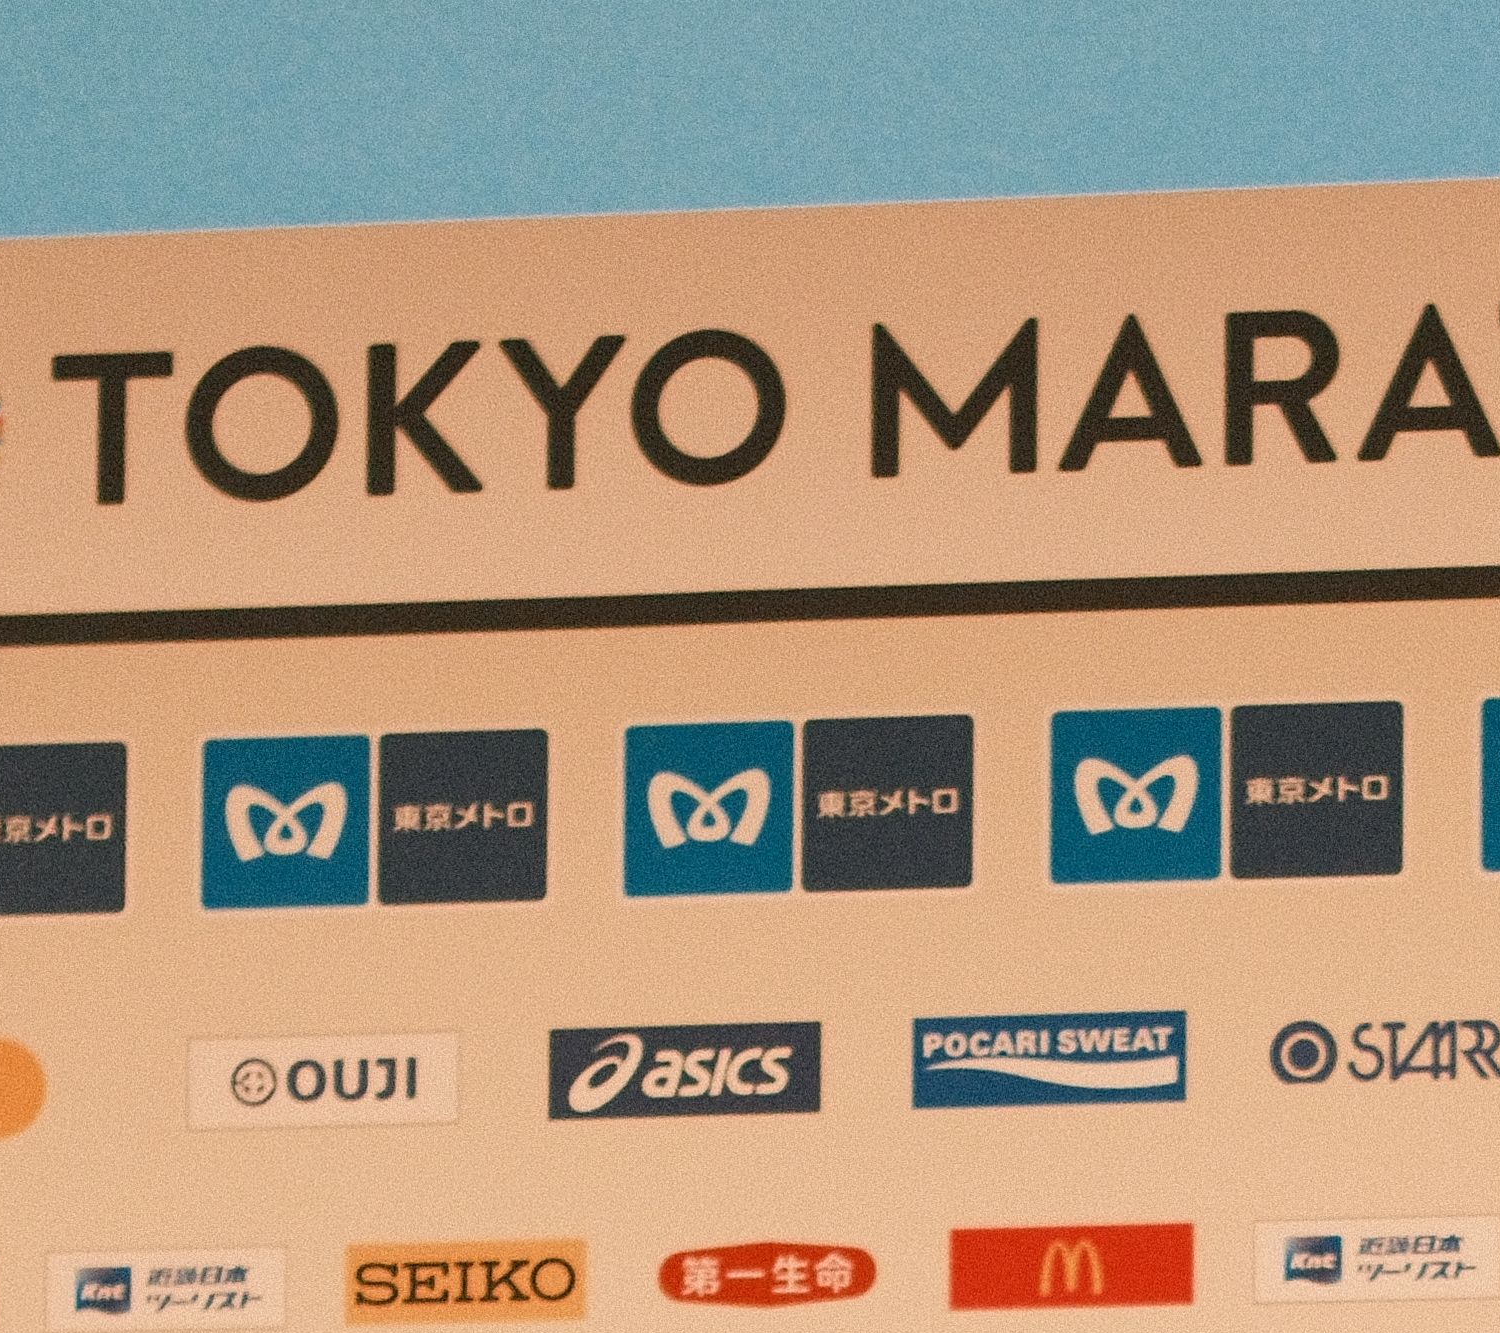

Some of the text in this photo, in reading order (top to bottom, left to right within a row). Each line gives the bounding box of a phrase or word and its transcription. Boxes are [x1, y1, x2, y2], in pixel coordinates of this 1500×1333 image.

[52, 329, 786, 505] TOKYO
[1248, 775, 1388, 803] 東京メトロ
[395, 802, 533, 830] 東京メトロ
[924, 1027, 1172, 1060] POCARI SWEAT
[287, 1057, 417, 1102] OUJI
[642, 1047, 791, 1097] asics
[355, 1257, 576, 1306] SEIKO
[683, 1253, 853, 1296] 第一生命
